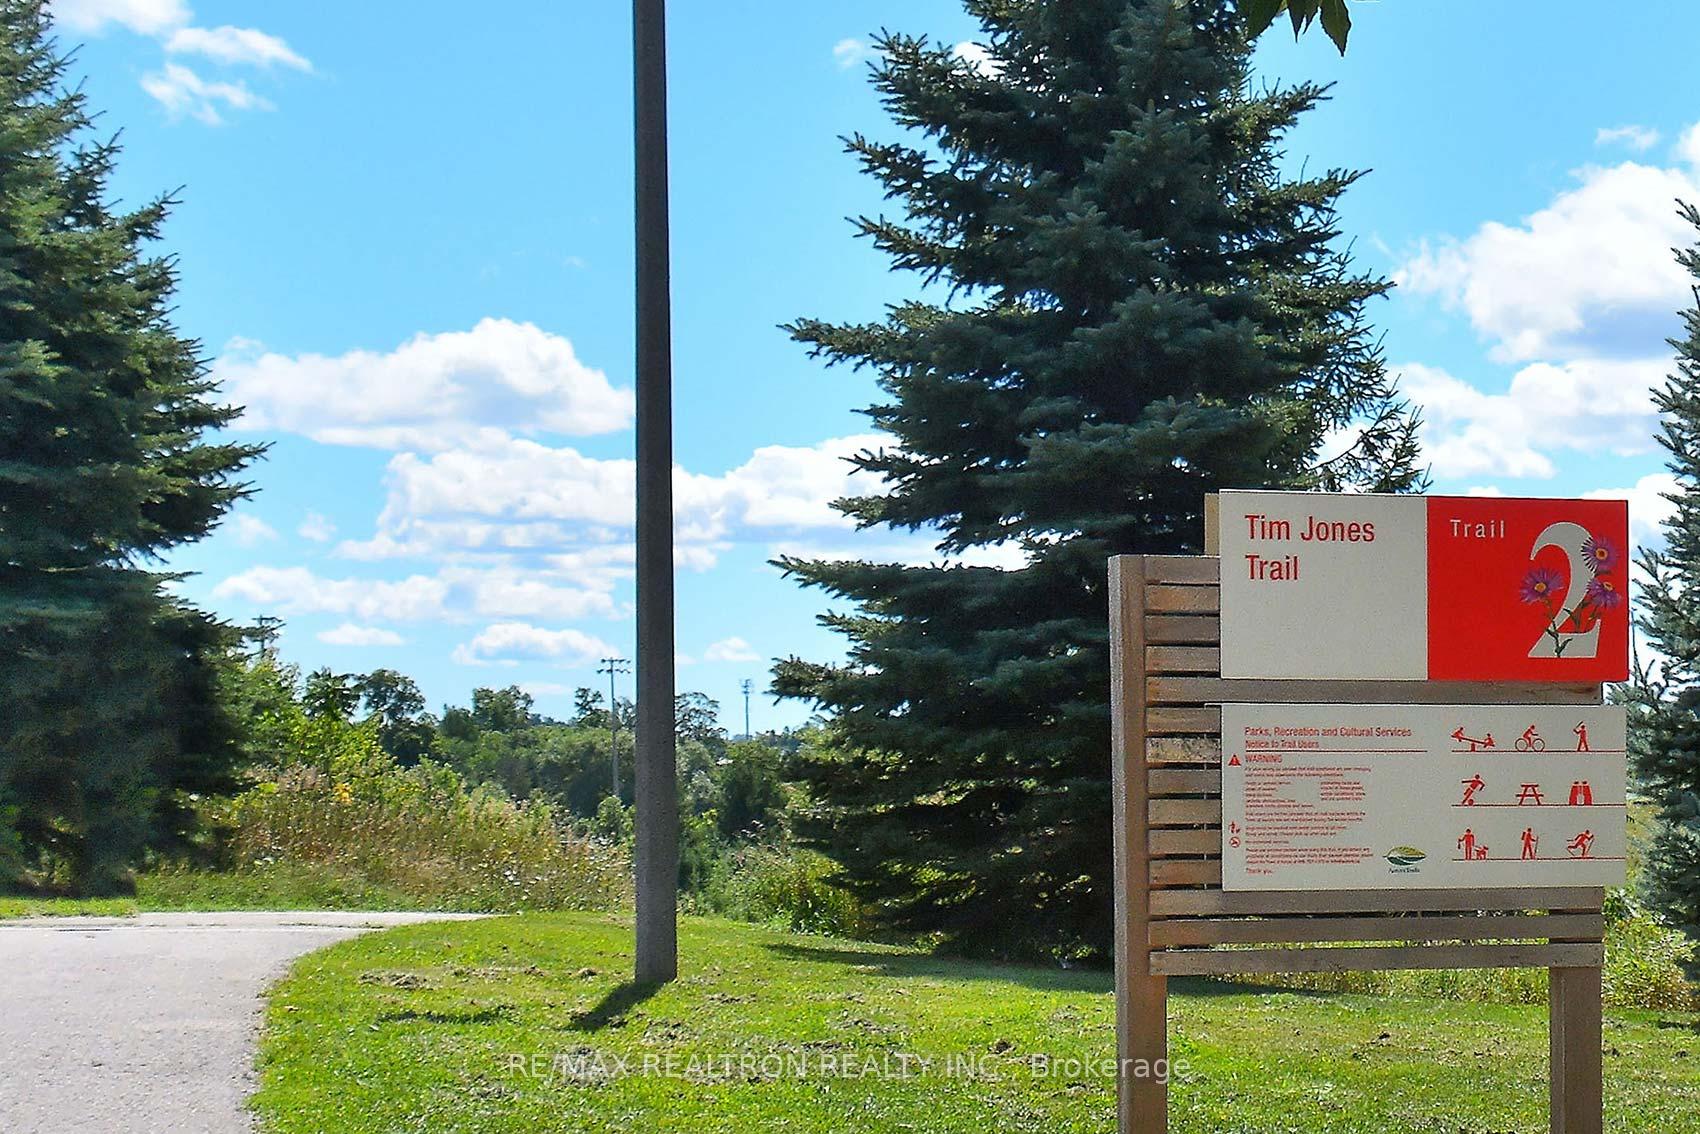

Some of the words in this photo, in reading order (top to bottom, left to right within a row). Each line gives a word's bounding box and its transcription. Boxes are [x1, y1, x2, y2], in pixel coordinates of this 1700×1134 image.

[1245, 514, 1291, 541] Tim
[1300, 515, 1376, 543] Jones
[1450, 518, 1505, 539] Trail
[1245, 554, 1299, 581] Trail
[1528, 521, 1601, 658] 2
[1244, 726, 1271, 737] Parks,
[1274, 726, 1319, 736] Recreation
[1321, 727, 1337, 737] and
[1340, 727, 1373, 736] Cultural
[1375, 727, 1412, 737] Services
[1245, 740, 1269, 749] Notice
[1271, 740, 1279, 749] to
[1281, 740, 1296, 749] Trail
[1245, 754, 1283, 763] WARNING
